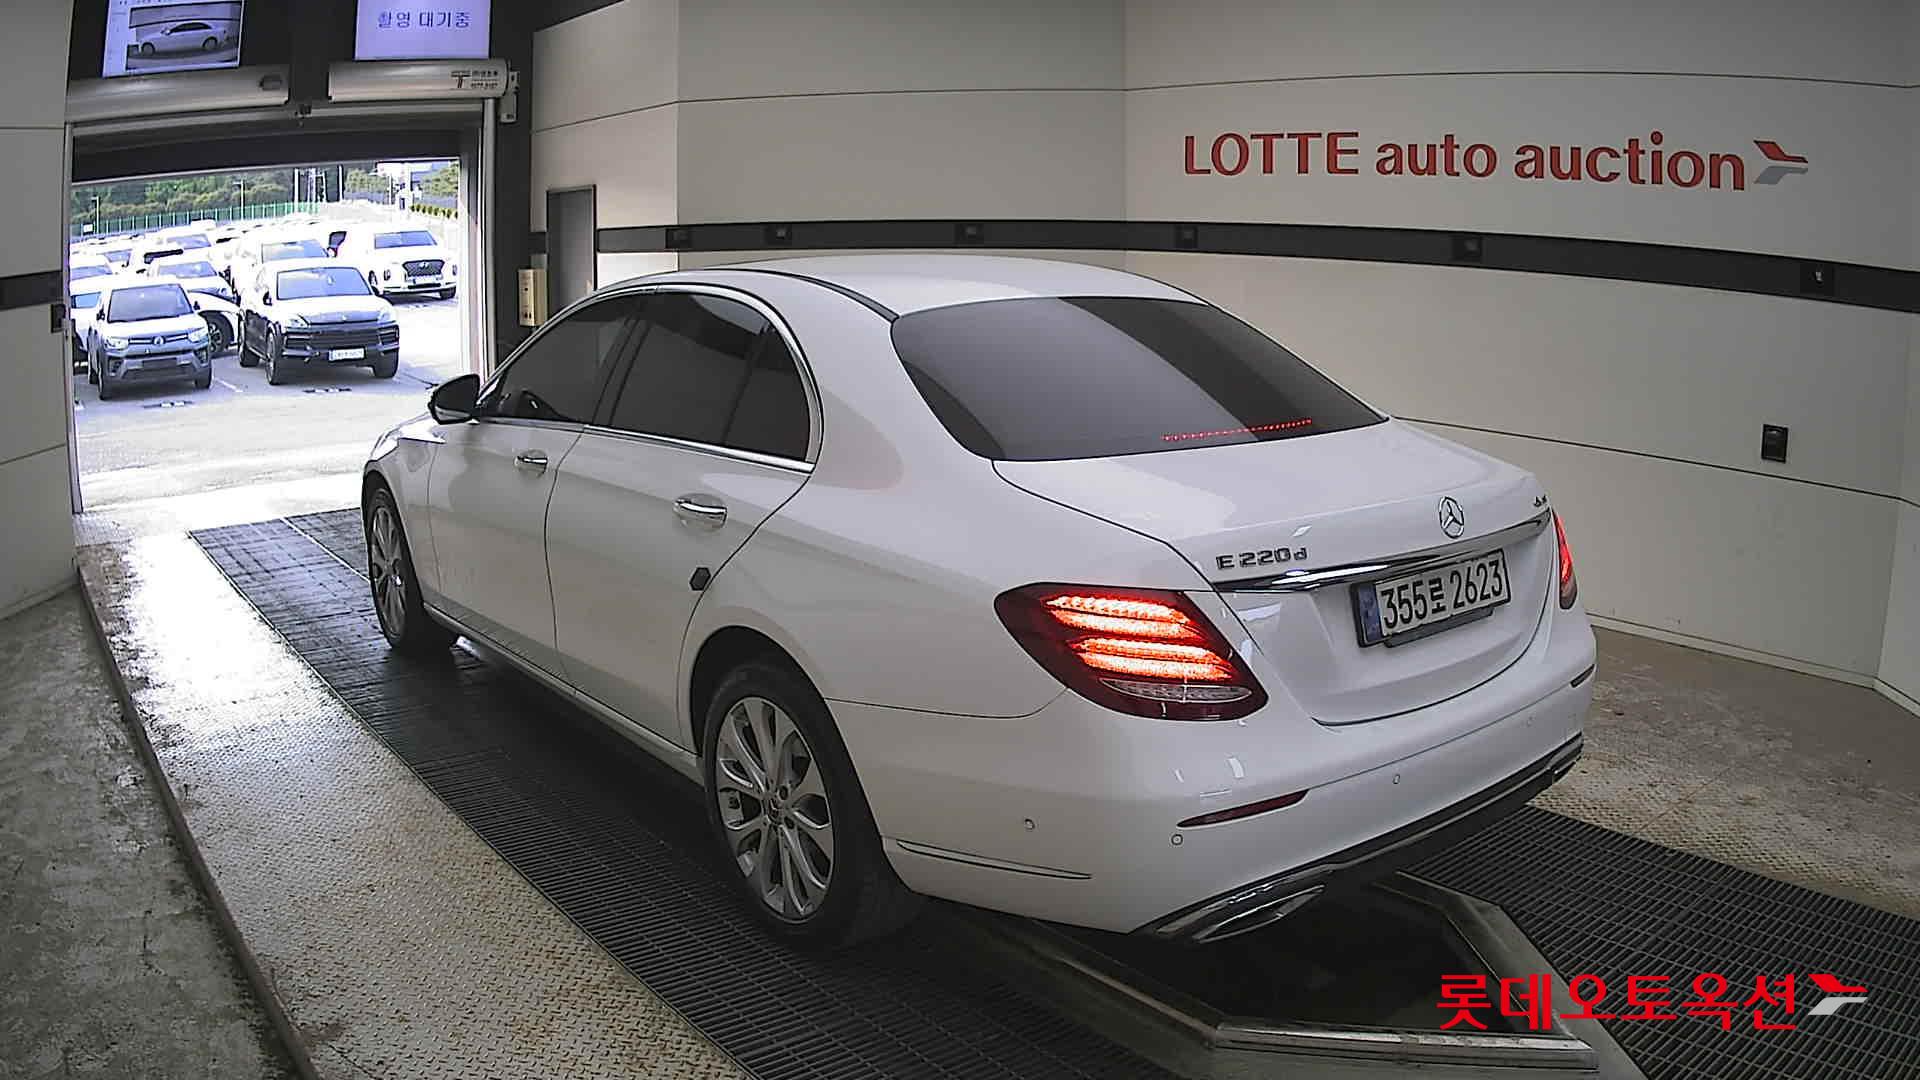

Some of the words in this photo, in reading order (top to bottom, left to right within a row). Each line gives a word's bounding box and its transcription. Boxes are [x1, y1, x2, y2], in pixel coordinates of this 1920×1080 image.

[418, 11, 470, 29] 대기중
[1184, 131, 1360, 177] LOTTE
[1375, 134, 1499, 179] auto
[1513, 130, 1746, 192] auction
[1449, 559, 1504, 610] 2623
